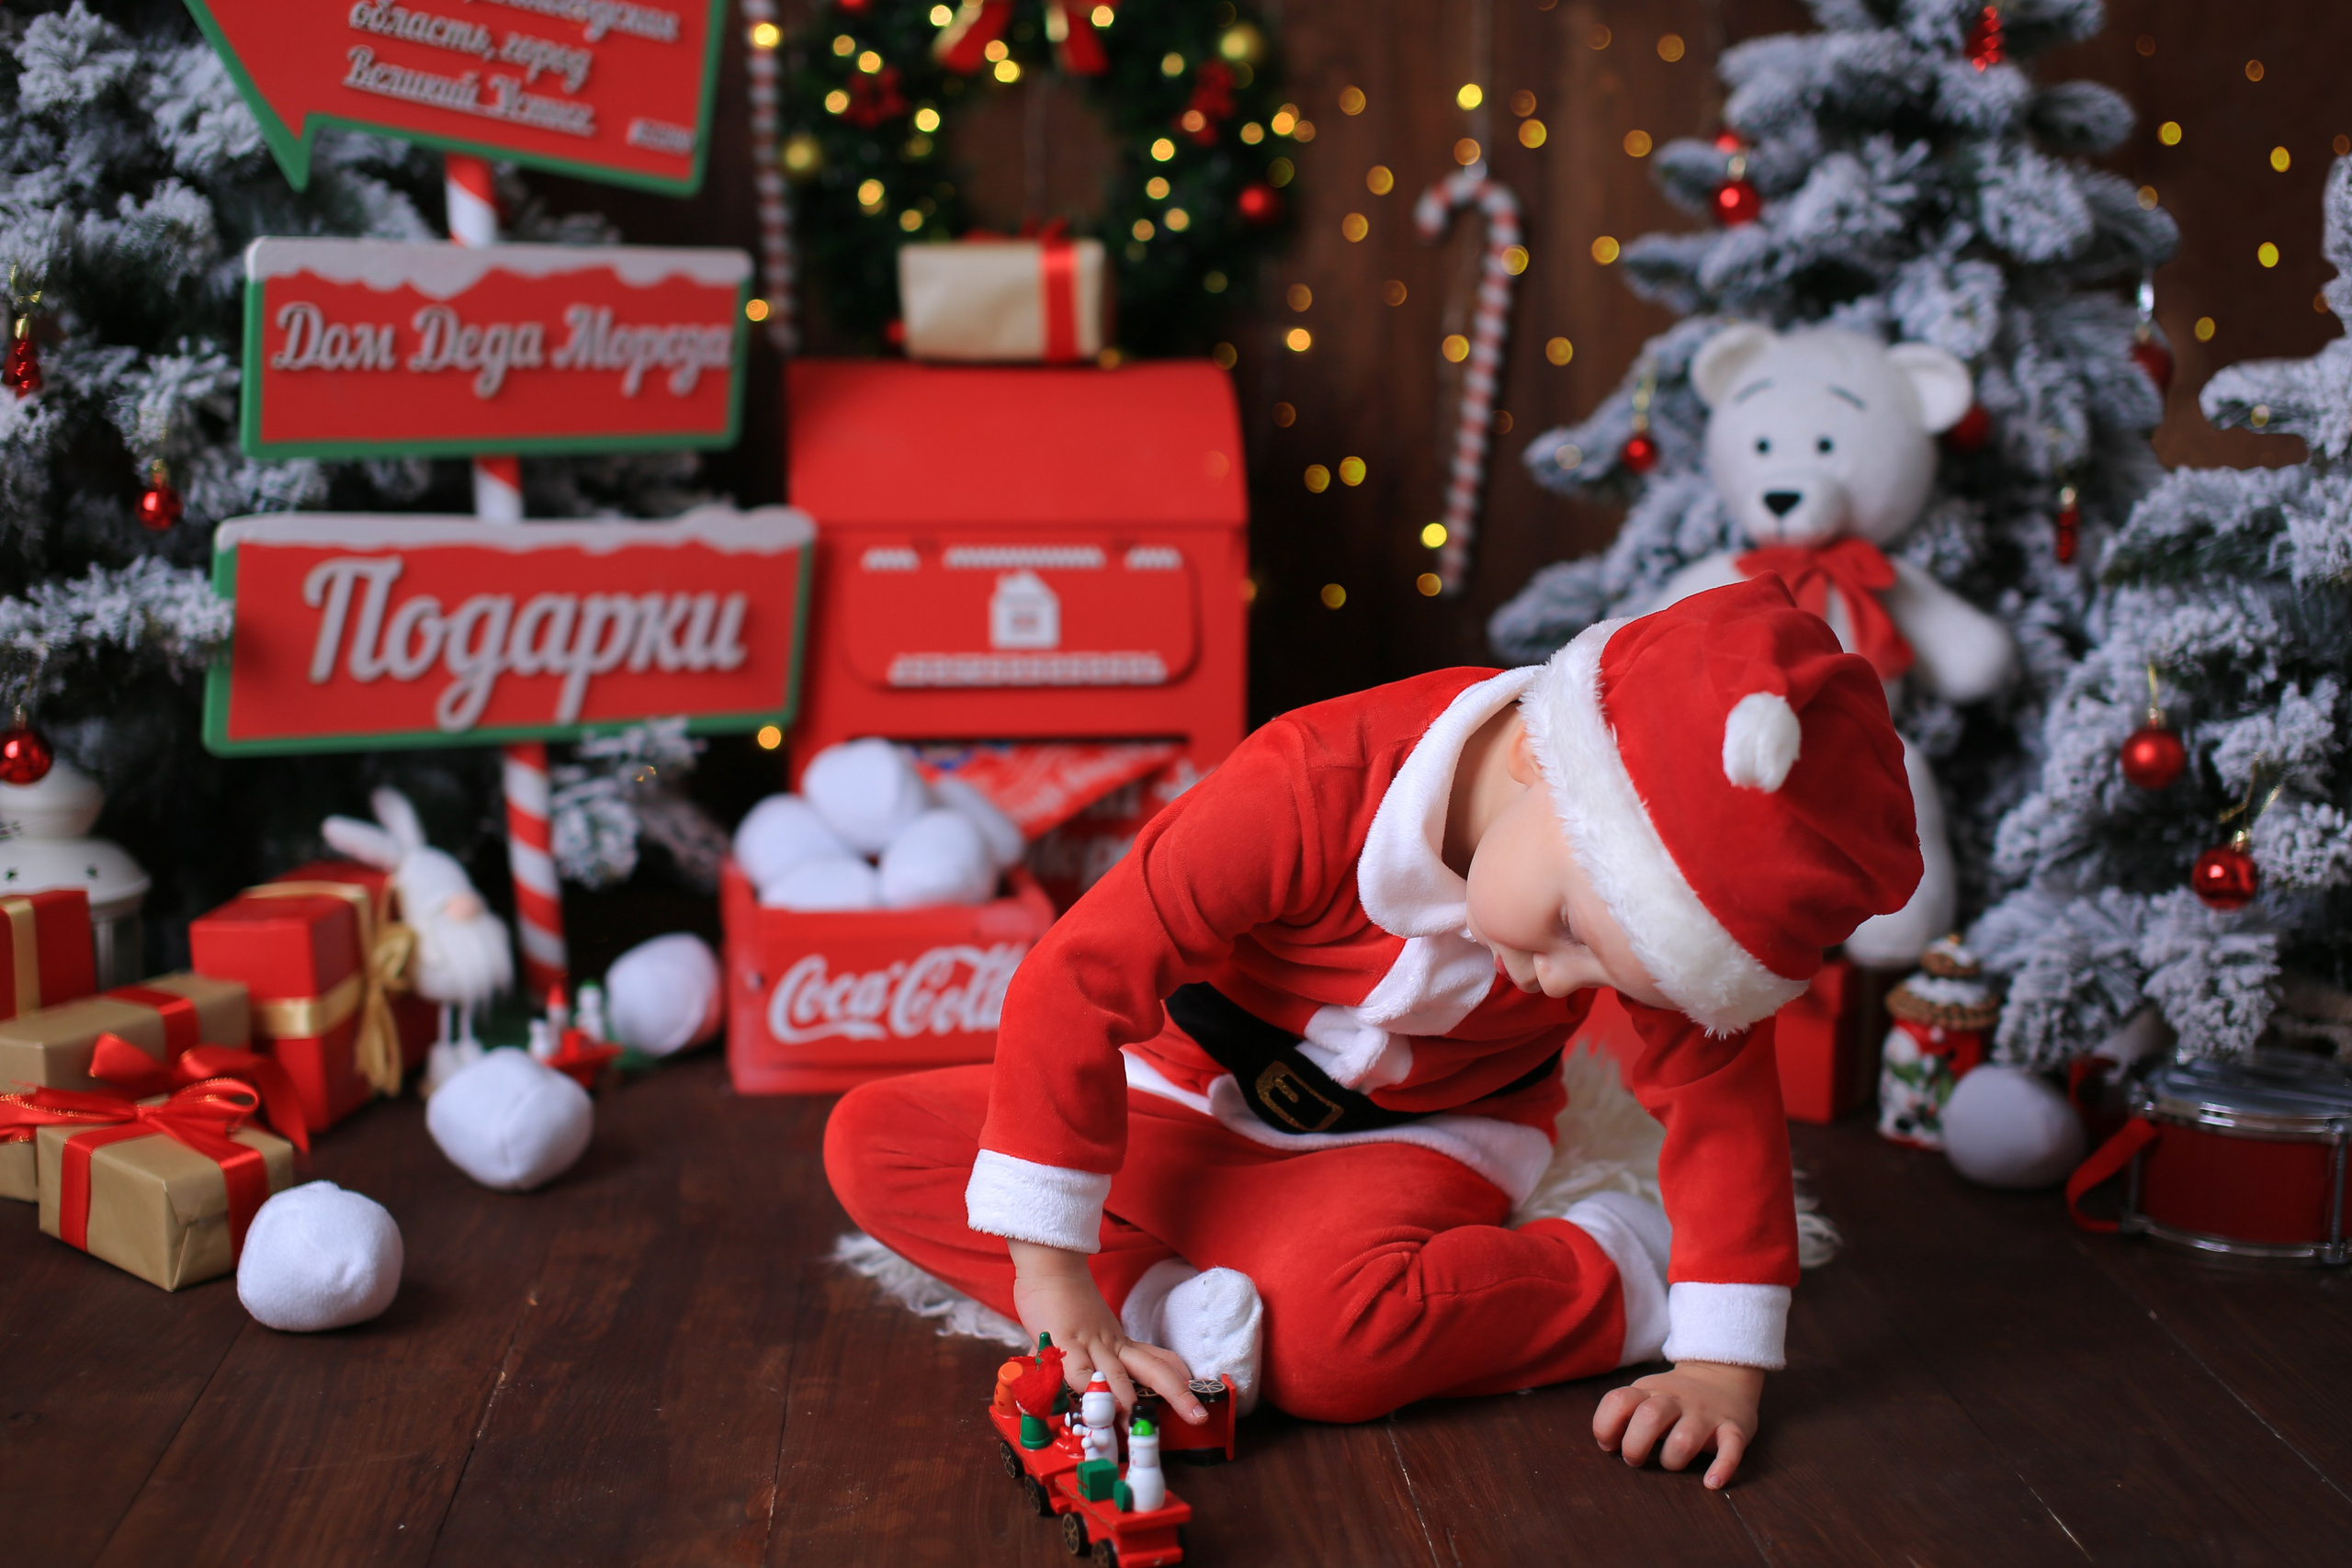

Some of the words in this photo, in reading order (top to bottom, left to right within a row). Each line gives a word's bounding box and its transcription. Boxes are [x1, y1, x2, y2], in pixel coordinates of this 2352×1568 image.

[341, 44, 481, 111] Великий
[499, 31, 594, 95] город
[272, 301, 396, 370] Дом
[409, 304, 545, 399] Деда
[553, 303, 733, 398] Мороза
[302, 554, 746, 733] Подарки
